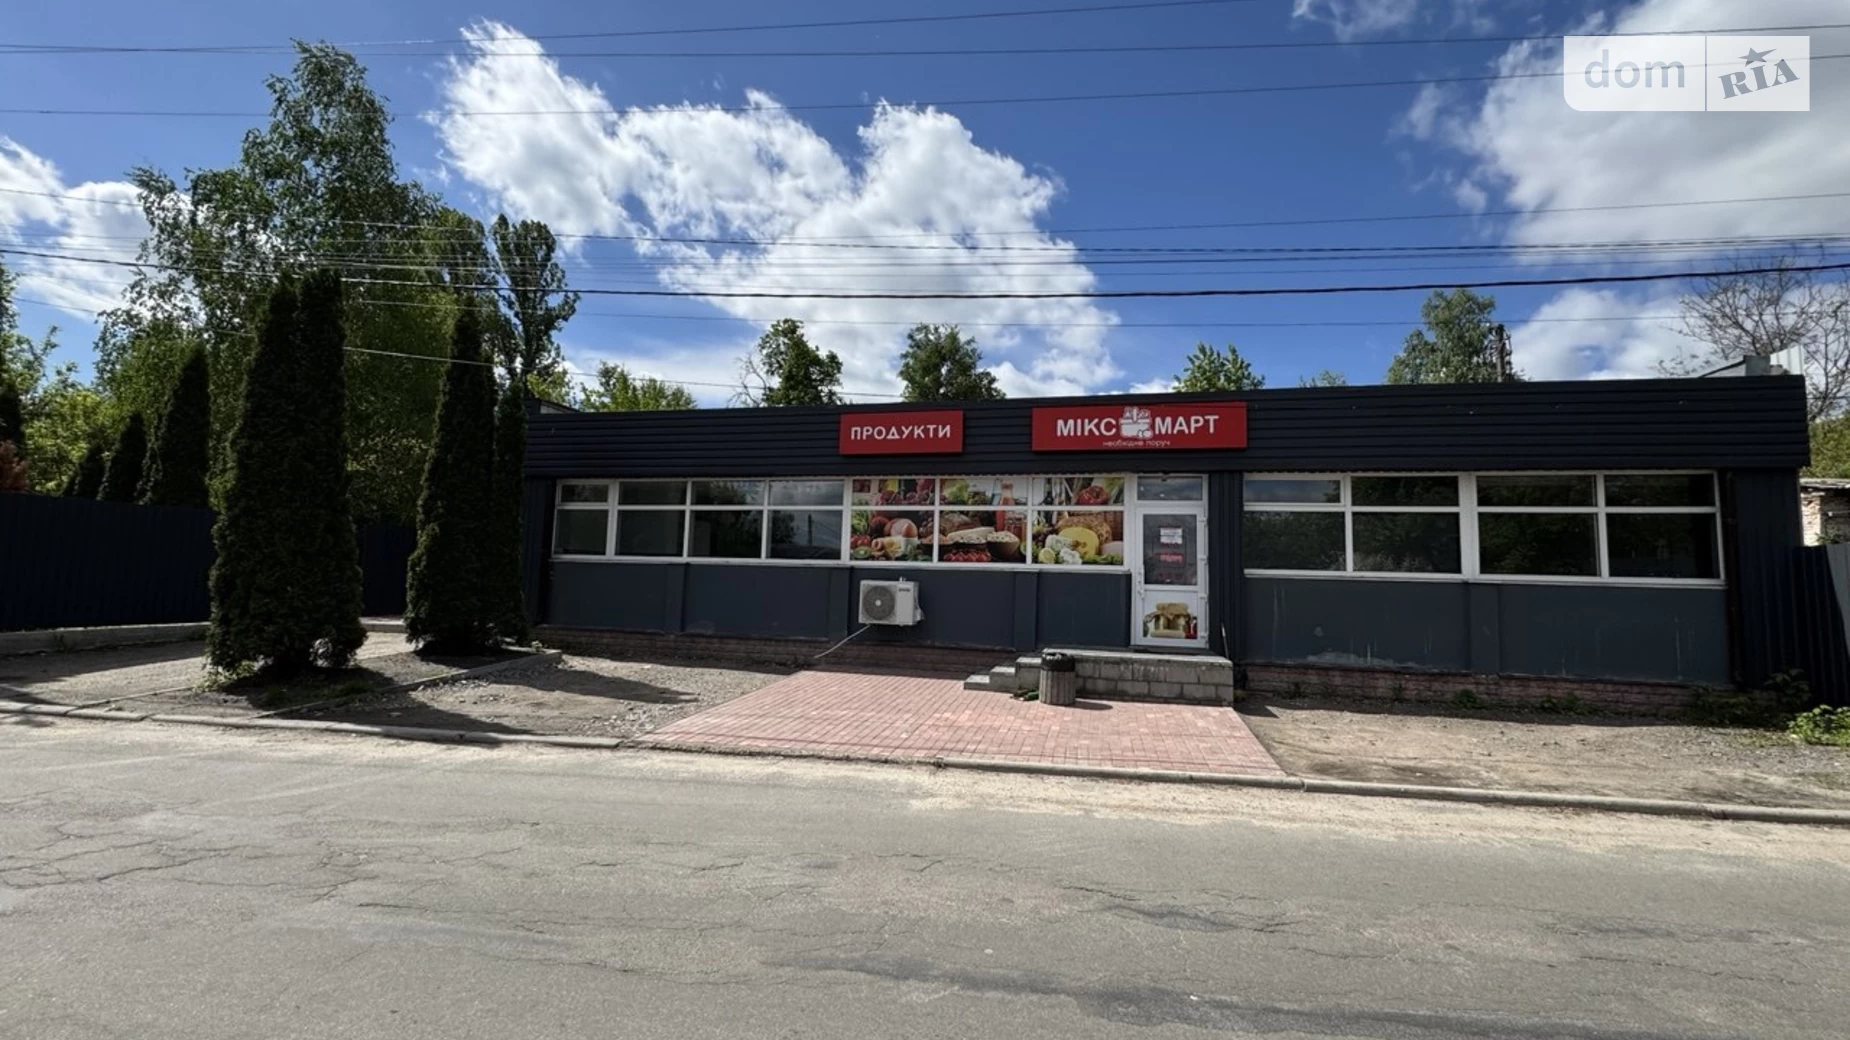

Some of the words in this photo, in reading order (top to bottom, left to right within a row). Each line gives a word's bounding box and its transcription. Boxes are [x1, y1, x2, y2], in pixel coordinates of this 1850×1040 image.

[850, 424, 951, 440] ПРОДУКТИ
[1056, 417, 1117, 437] МІКС
[1154, 415, 1219, 435] МАРТ
[1145, 440, 1171, 448] поруч
